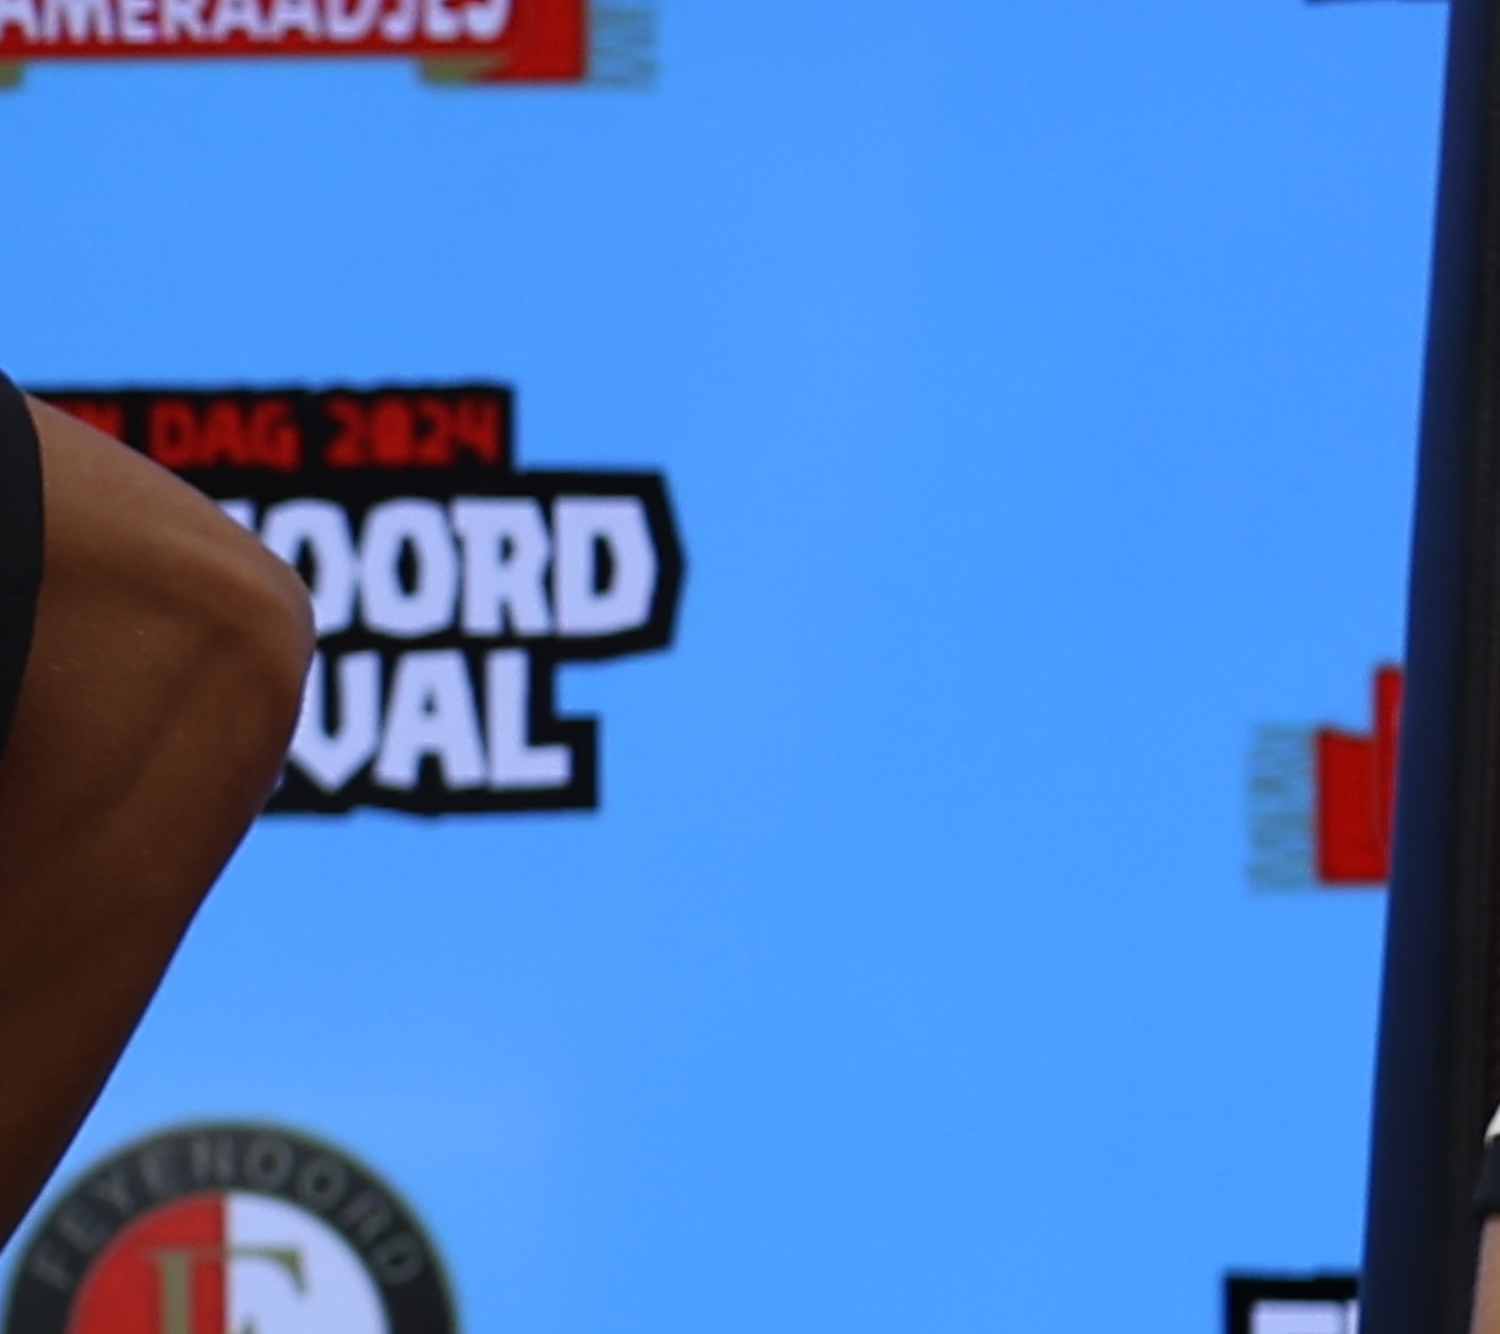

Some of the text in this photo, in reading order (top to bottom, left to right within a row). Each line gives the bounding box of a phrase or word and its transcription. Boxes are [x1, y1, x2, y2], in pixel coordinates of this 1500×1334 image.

[146, 397, 303, 474] DAG
[323, 394, 501, 467] 2024
[26, 1133, 424, 1293] FEYENOORD
